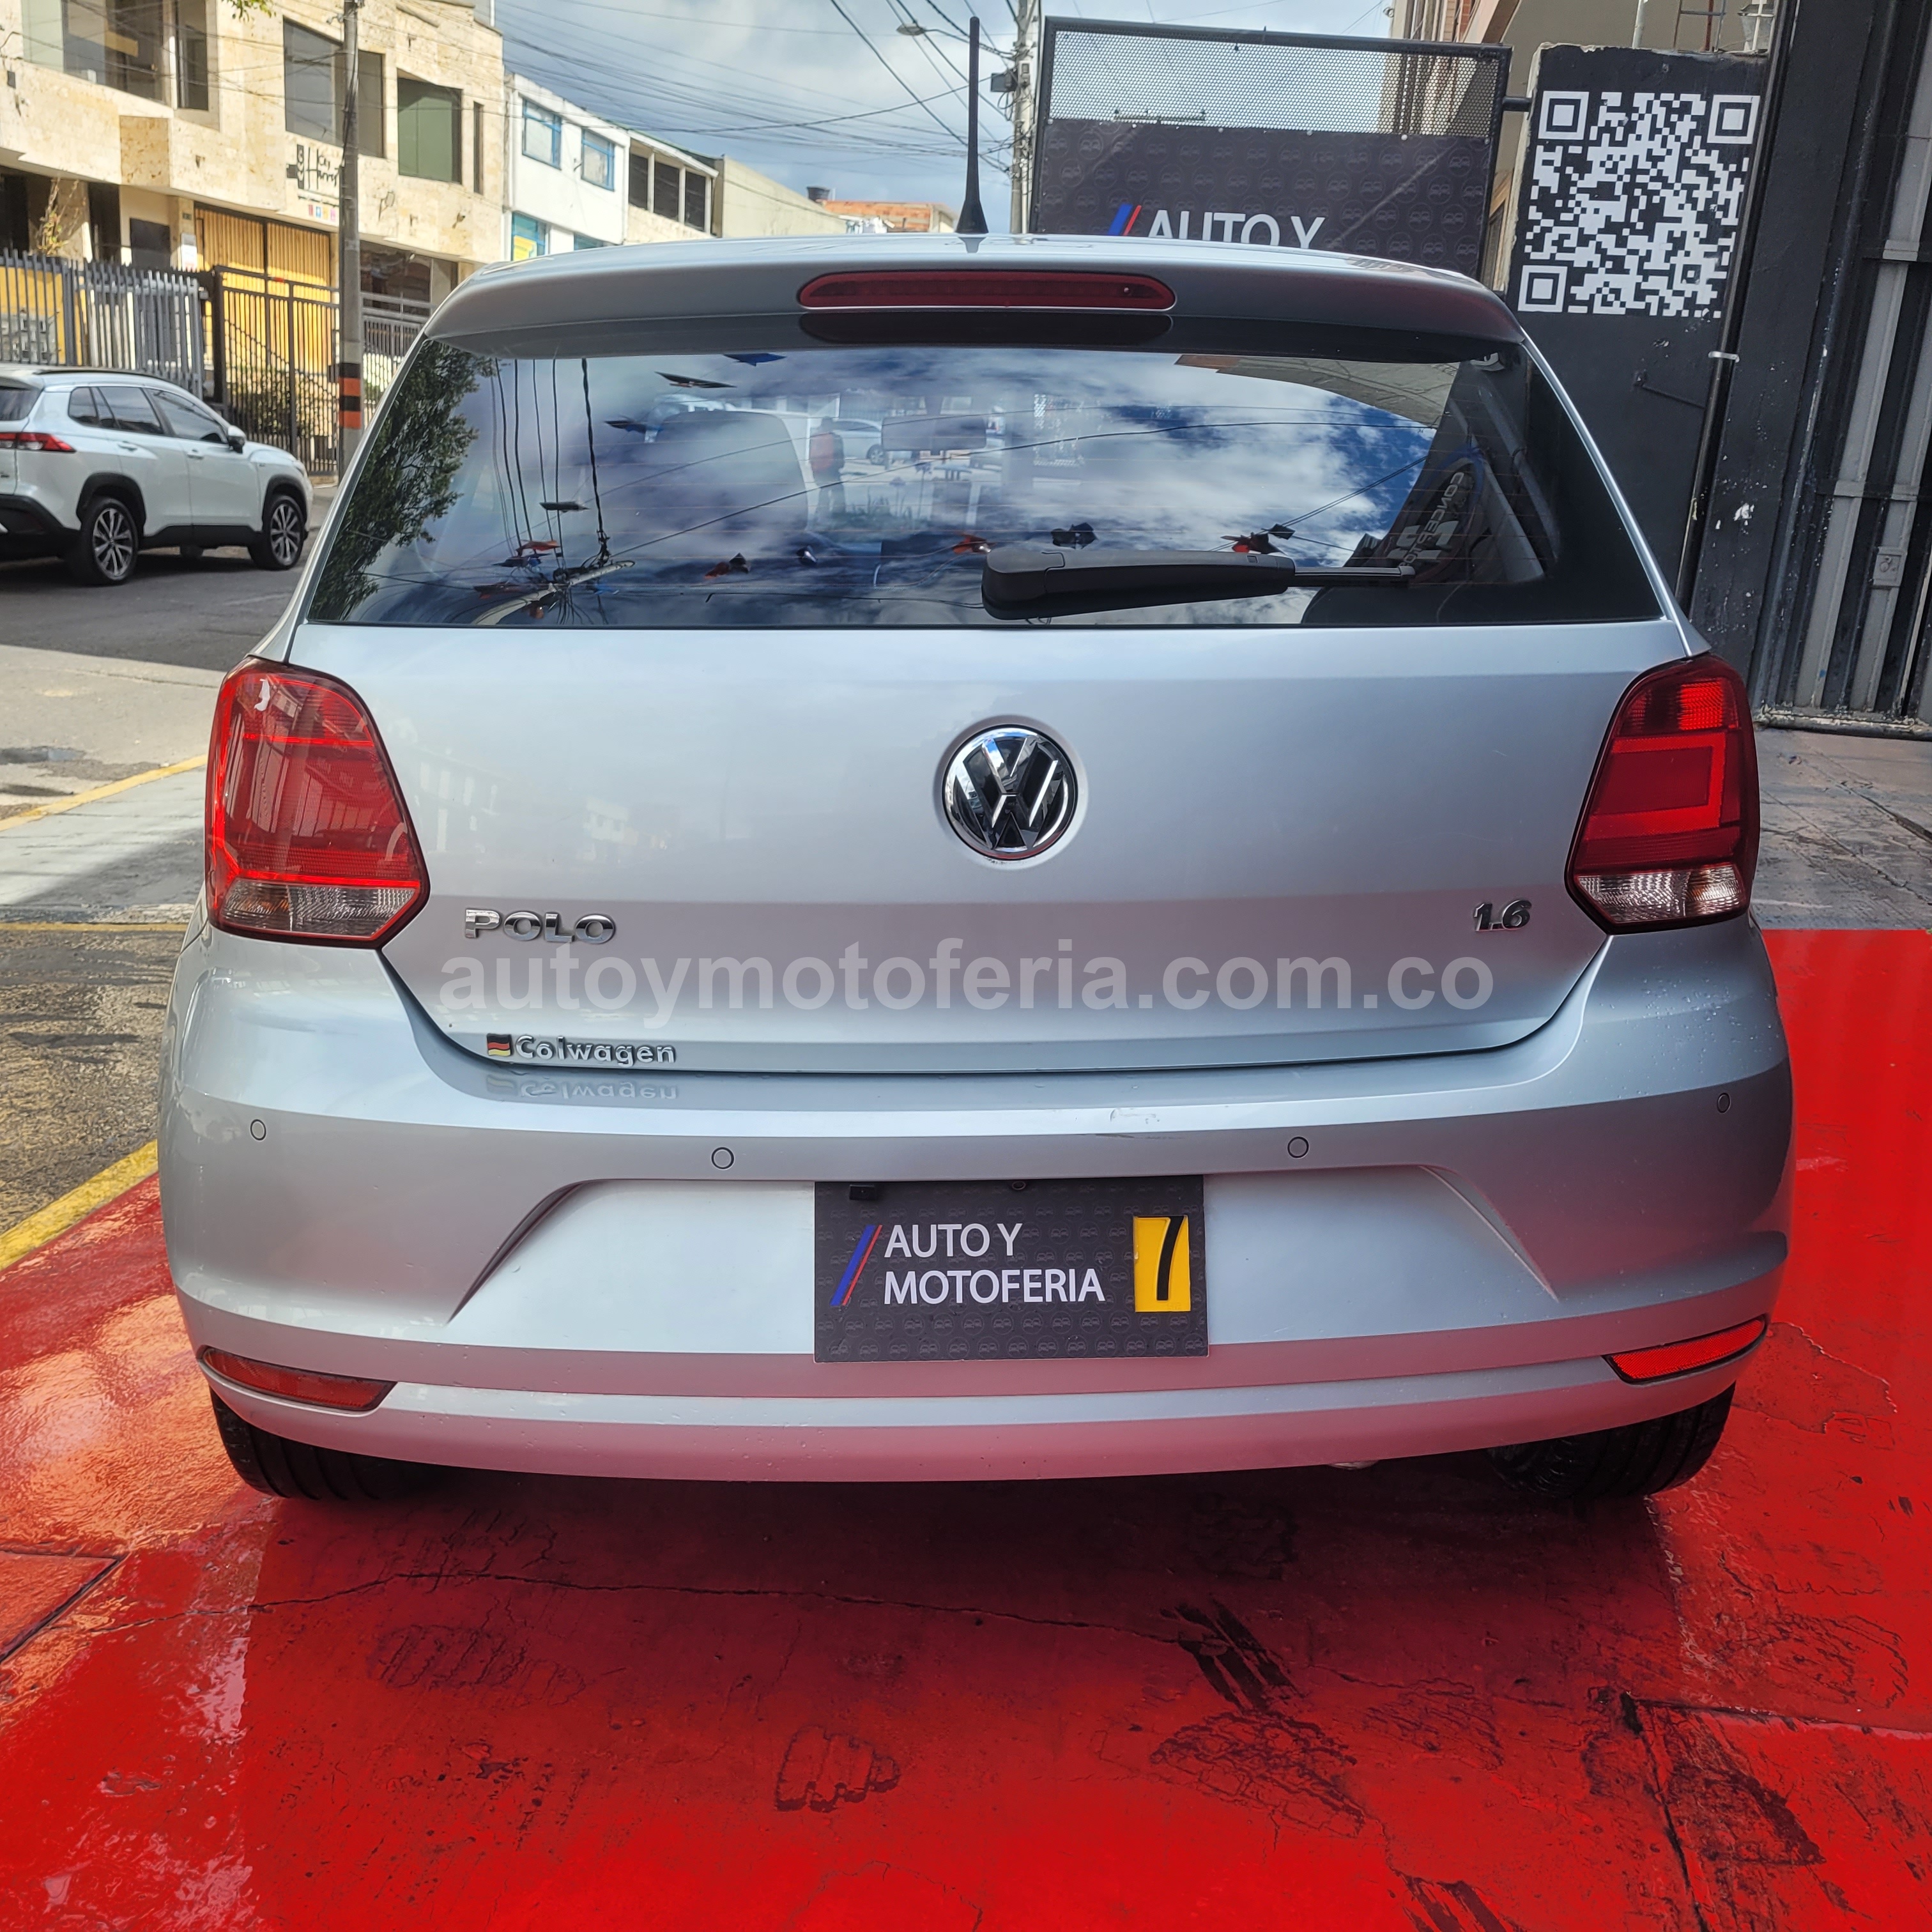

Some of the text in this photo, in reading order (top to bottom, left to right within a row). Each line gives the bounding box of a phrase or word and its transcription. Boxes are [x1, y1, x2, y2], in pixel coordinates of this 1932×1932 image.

[1148, 210, 1326, 249] AUTO Y
[464, 908, 617, 944] POLO
[1473, 900, 1532, 932] 1.6
[515, 1035, 677, 1068] Colwagen
[884, 1223, 1023, 1258] AUTO Y
[1137, 1215, 1184, 1301] 7
[884, 1268, 1106, 1305] MOTOFERIA
